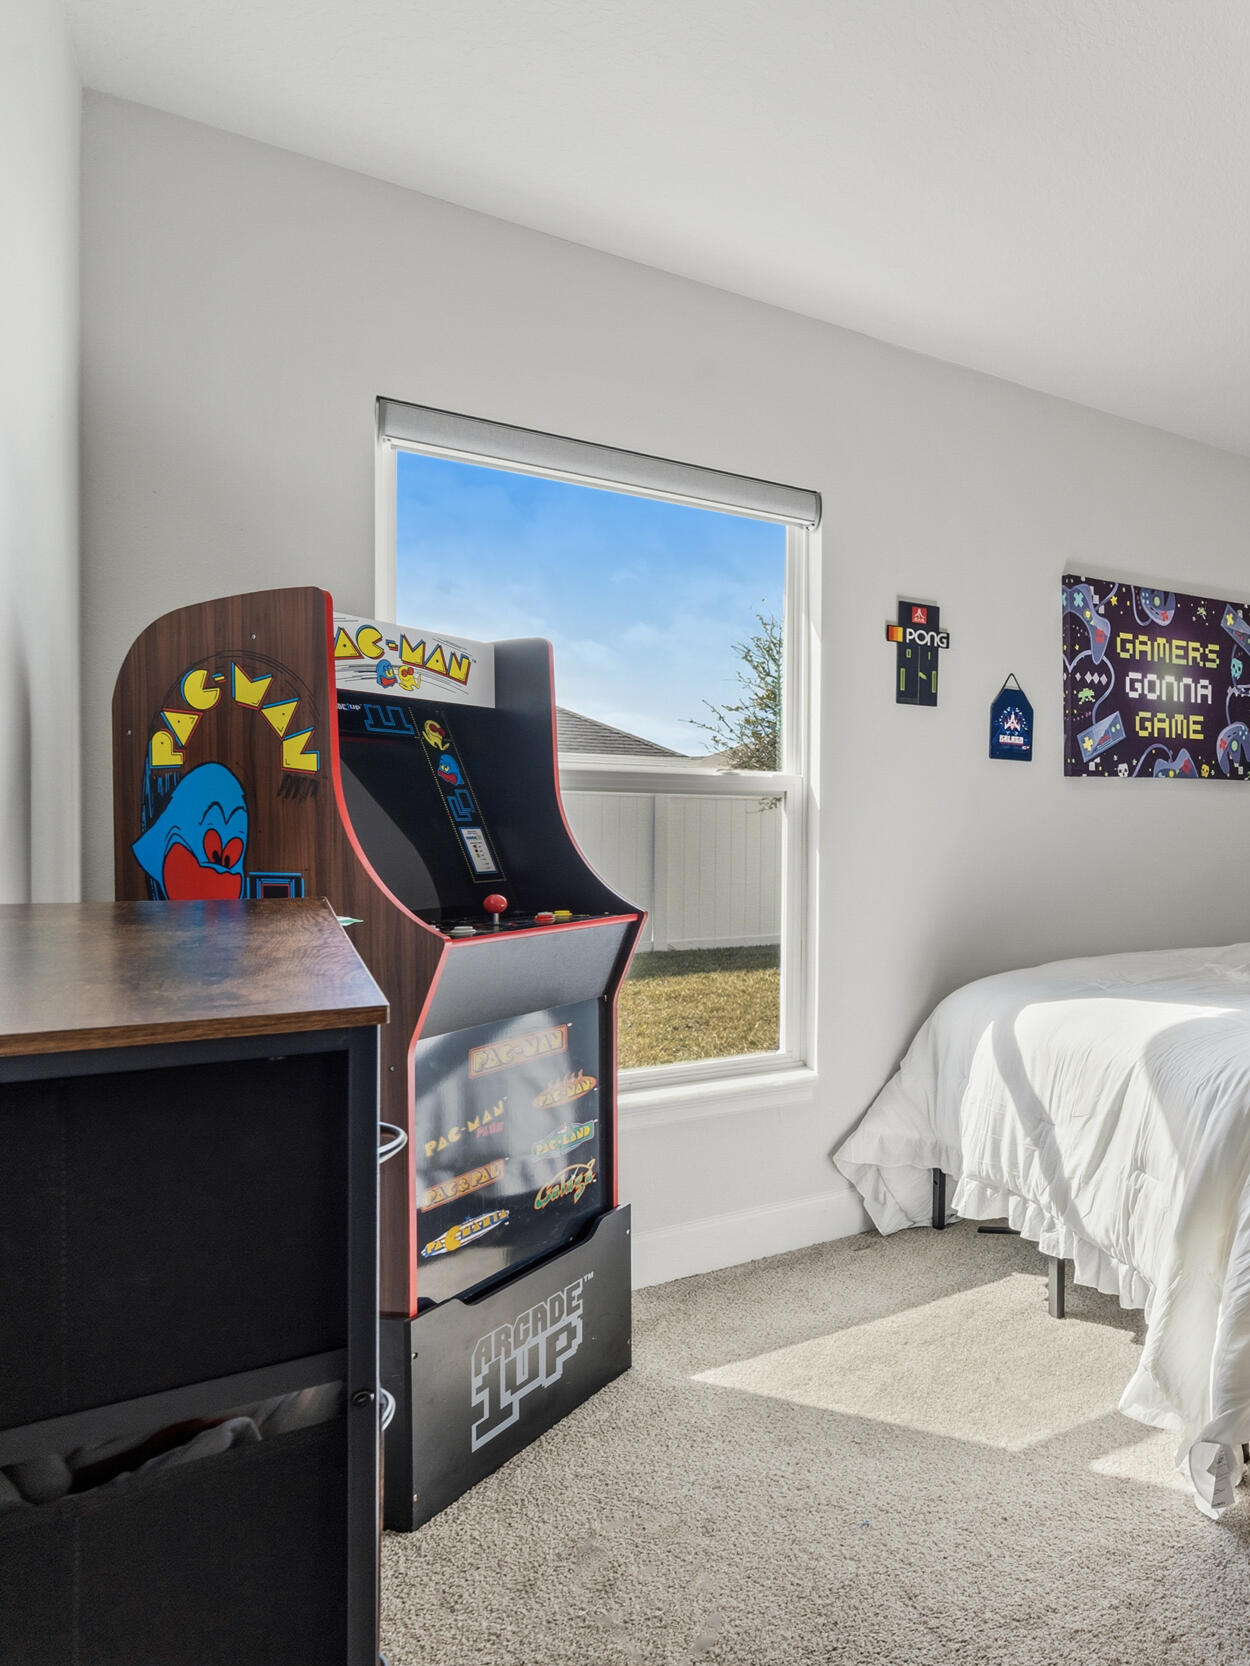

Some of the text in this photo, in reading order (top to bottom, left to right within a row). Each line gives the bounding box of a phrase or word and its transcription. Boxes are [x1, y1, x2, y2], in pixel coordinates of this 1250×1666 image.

[333, 624, 471, 686] AC-MAN
[906, 628, 947, 648] PONG
[1117, 632, 1220, 668] GAMERS
[1125, 672, 1212, 704] GONNA
[149, 661, 320, 774] PAC-MAN
[1136, 711, 1204, 739] GAME
[473, 1029, 564, 1073] PAC-MAN
[424, 1100, 504, 1158] PAC-MAN
[535, 1125, 591, 1156] PAC-LAND
[424, 1182, 457, 1207] PAC
[459, 1178, 470, 1192] &
[472, 1278, 584, 1380] ARCADE
[472, 1319, 583, 1453] 1UP
